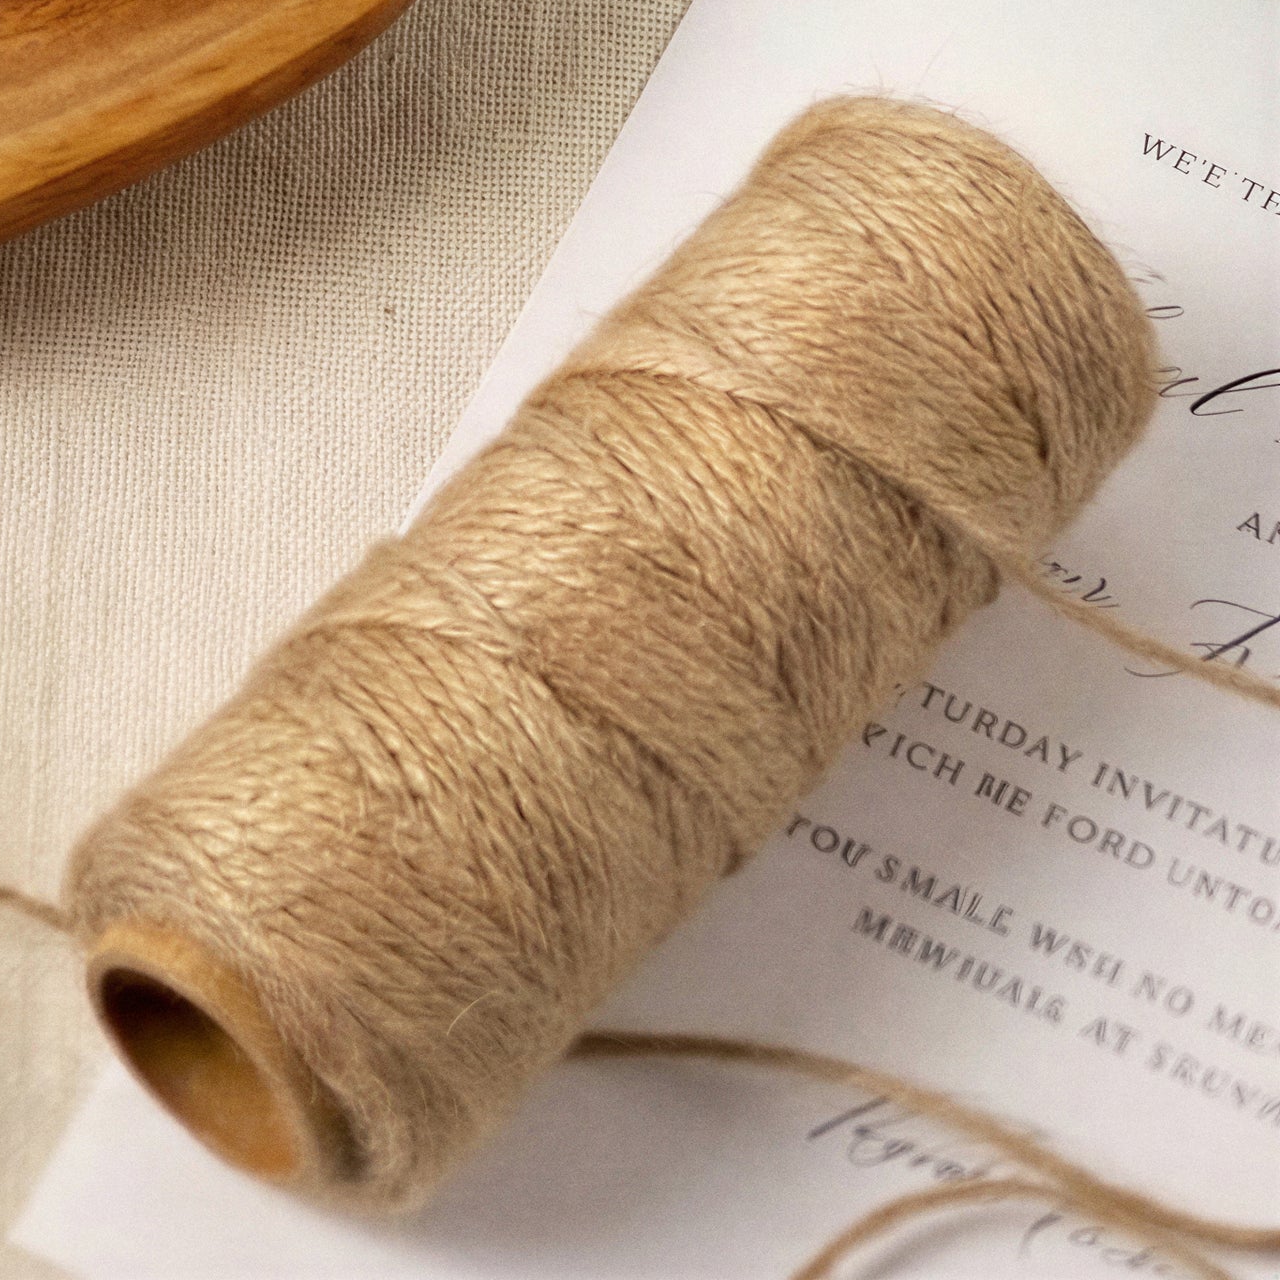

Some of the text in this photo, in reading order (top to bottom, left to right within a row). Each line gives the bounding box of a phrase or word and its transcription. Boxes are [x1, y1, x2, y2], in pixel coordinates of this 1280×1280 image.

[895, 681, 1084, 772] TURDAY
[1041, 801, 1156, 870] FORD
[1167, 856, 1280, 934] UNTO
